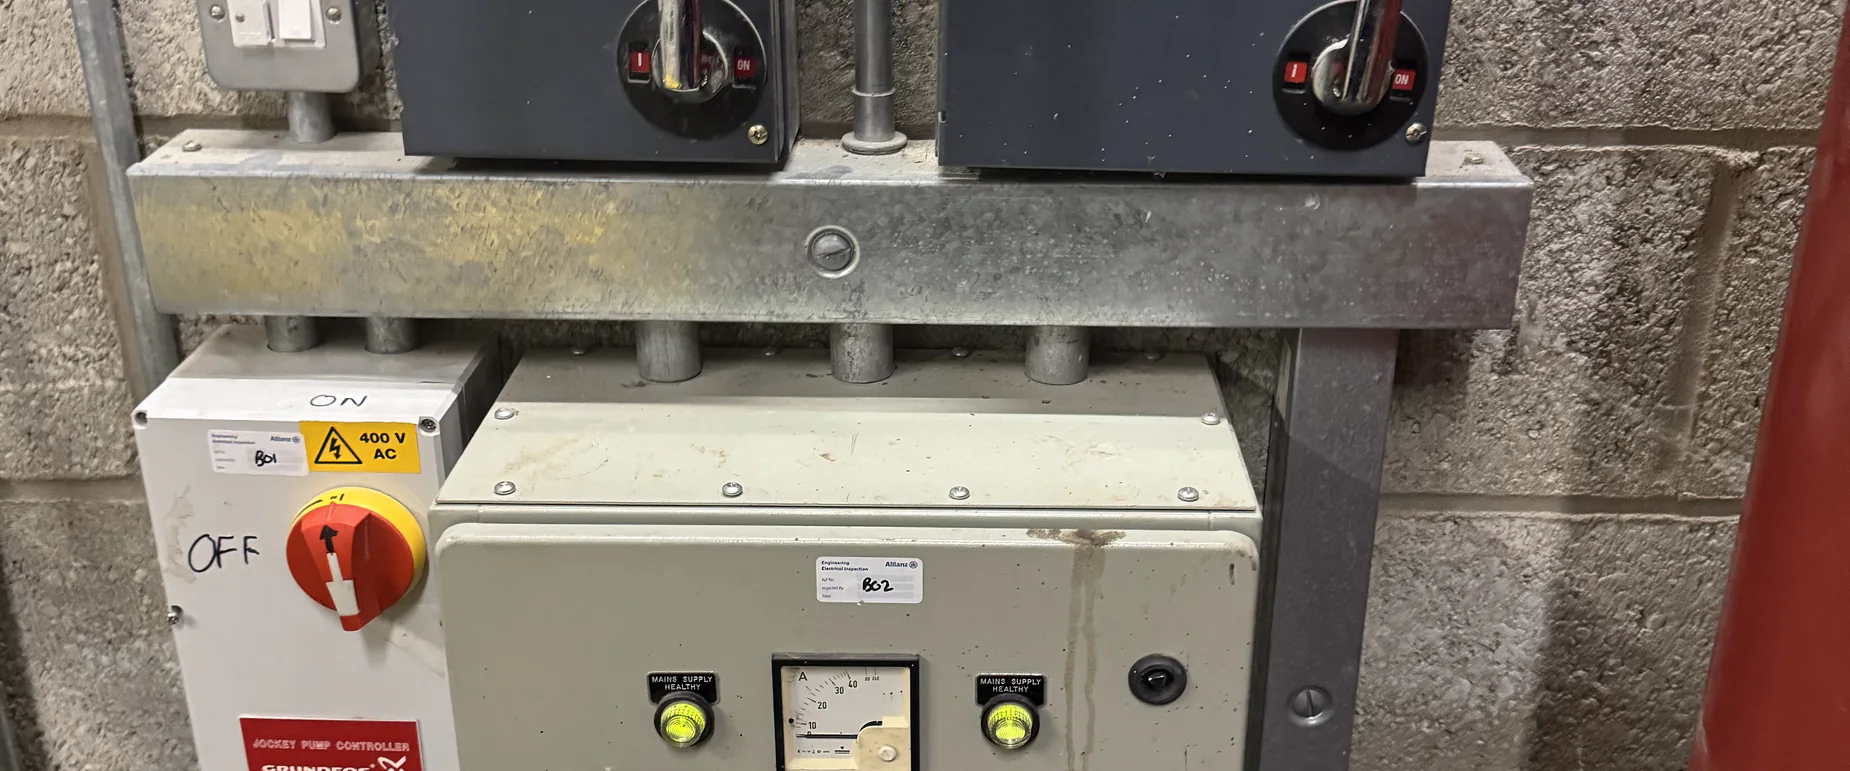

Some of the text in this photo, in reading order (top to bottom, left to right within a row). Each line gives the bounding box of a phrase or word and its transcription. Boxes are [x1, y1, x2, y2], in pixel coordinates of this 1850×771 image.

[737, 59, 750, 71] ON
[1394, 75, 1409, 85] ON
[309, 394, 367, 407] ON
[359, 432, 406, 444] 400 V
[373, 448, 397, 459] AC
[188, 533, 260, 573] OFF
[798, 671, 808, 681] A
[848, 680, 858, 688] 40
[834, 686, 844, 694] 30
[817, 701, 827, 709] 20
[808, 721, 817, 730] 10
[253, 738, 410, 751] JOCKEY PUMP CONTROLLER
